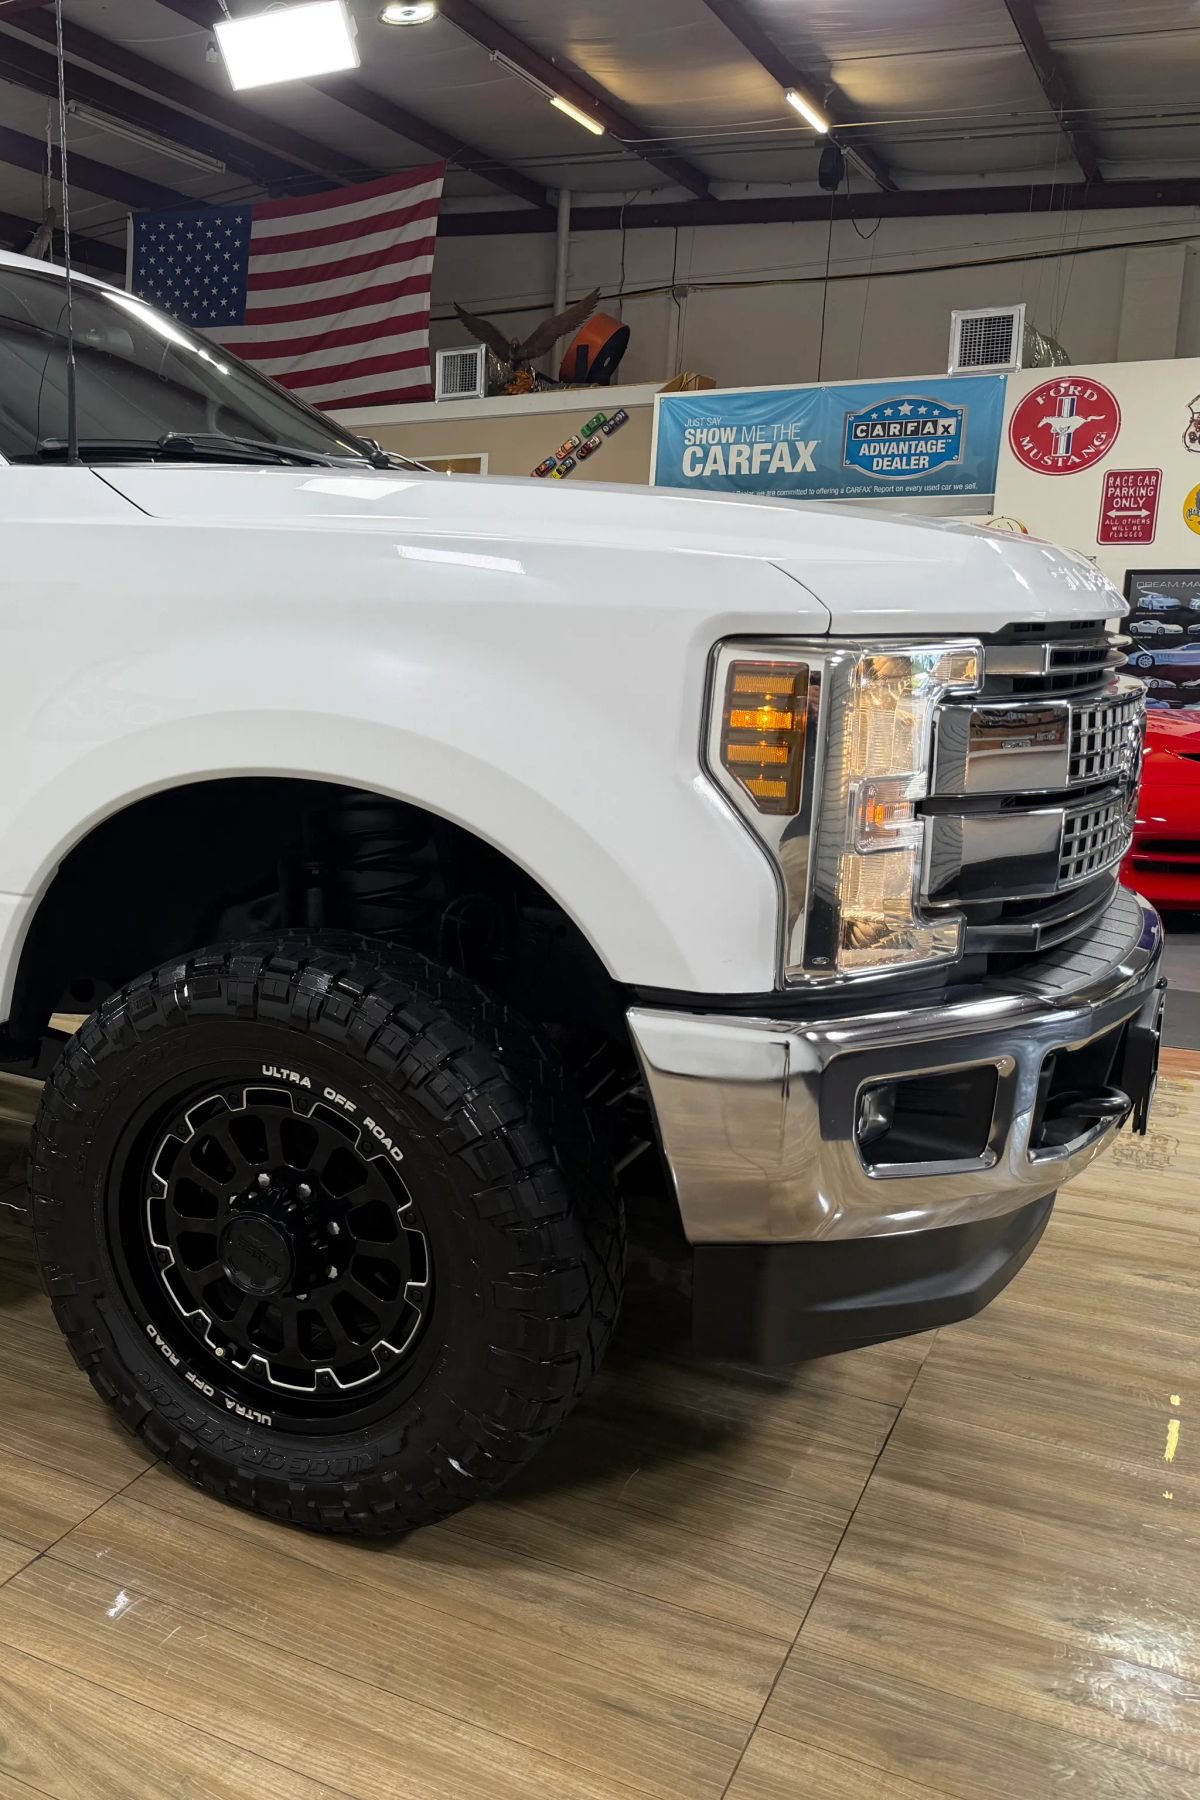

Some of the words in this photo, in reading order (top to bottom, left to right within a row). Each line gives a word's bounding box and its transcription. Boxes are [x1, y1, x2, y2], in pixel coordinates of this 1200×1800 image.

[1035, 384, 1098, 406] FORD
[684, 418, 705, 428] JUST
[706, 416, 722, 426] SAY
[855, 419, 953, 438] CARFAX
[684, 427, 737, 445] SHOW
[741, 425, 766, 443] ME
[771, 423, 801, 441] THE
[682, 440, 819, 478] CARFAX
[1019, 431, 1108, 467] MUSTANG
[872, 455, 929, 471] DEALER
[777, 488, 807, 496] committed
[815, 487, 839, 496] offering
[846, 485, 872, 494] CARFAX
[874, 485, 894, 494] Report
[905, 485, 923, 493] every
[924, 483, 940, 492] used
[953, 483, 963, 491] we
[1108, 475, 1134, 487] RACE
[1137, 475, 1157, 487] CAR
[1108, 486, 1154, 497] PARKING
[1113, 497, 1146, 508] ONLY
[1136, 581, 1179, 589] DREAM
[262, 1064, 312, 1089] ULTRA
[323, 1087, 357, 1112] OFF
[363, 1116, 404, 1161] ROAD
[146, 1324, 180, 1366] ROAD
[185, 1371, 214, 1397] OFF
[224, 1397, 272, 1426] ULTRA
